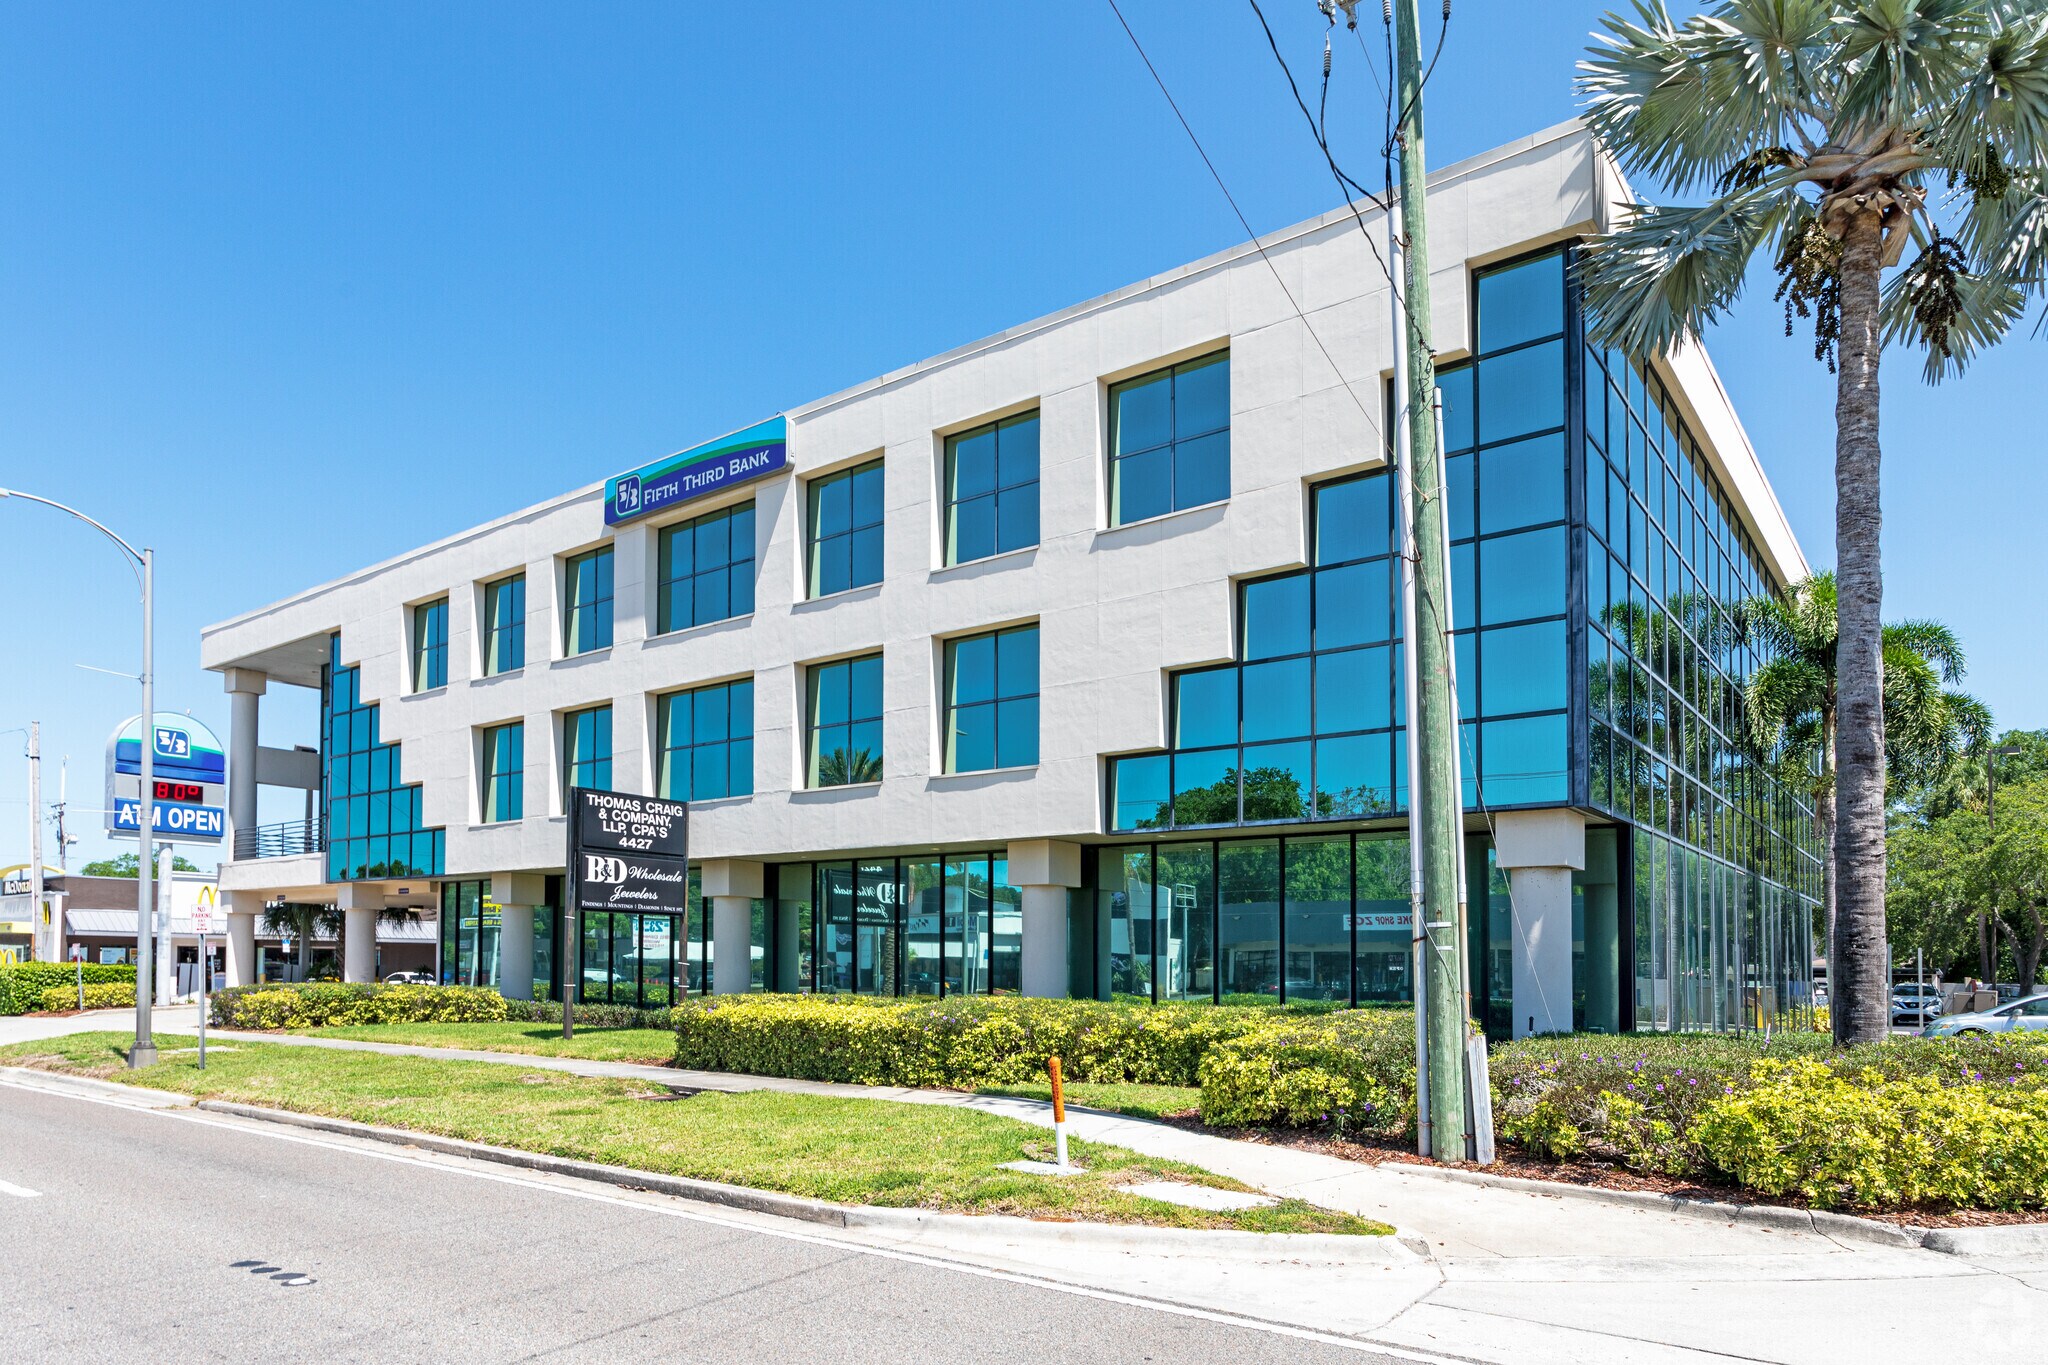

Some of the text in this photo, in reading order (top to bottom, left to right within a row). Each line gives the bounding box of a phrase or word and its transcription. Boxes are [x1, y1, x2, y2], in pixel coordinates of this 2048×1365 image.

[644, 481, 678, 505] FIFTH
[683, 466, 725, 491] THIRD
[729, 450, 769, 476] BANK
[586, 793, 683, 817] THOMAS CRAIG
[167, 807, 221, 832] OPEN
[598, 807, 672, 829] & COMPANY,
[602, 820, 668, 838] LLP, CPA'S
[618, 836, 653, 850] 4427
[584, 854, 683, 884] B&D Wholesale
[609, 884, 659, 902] Jewelers
